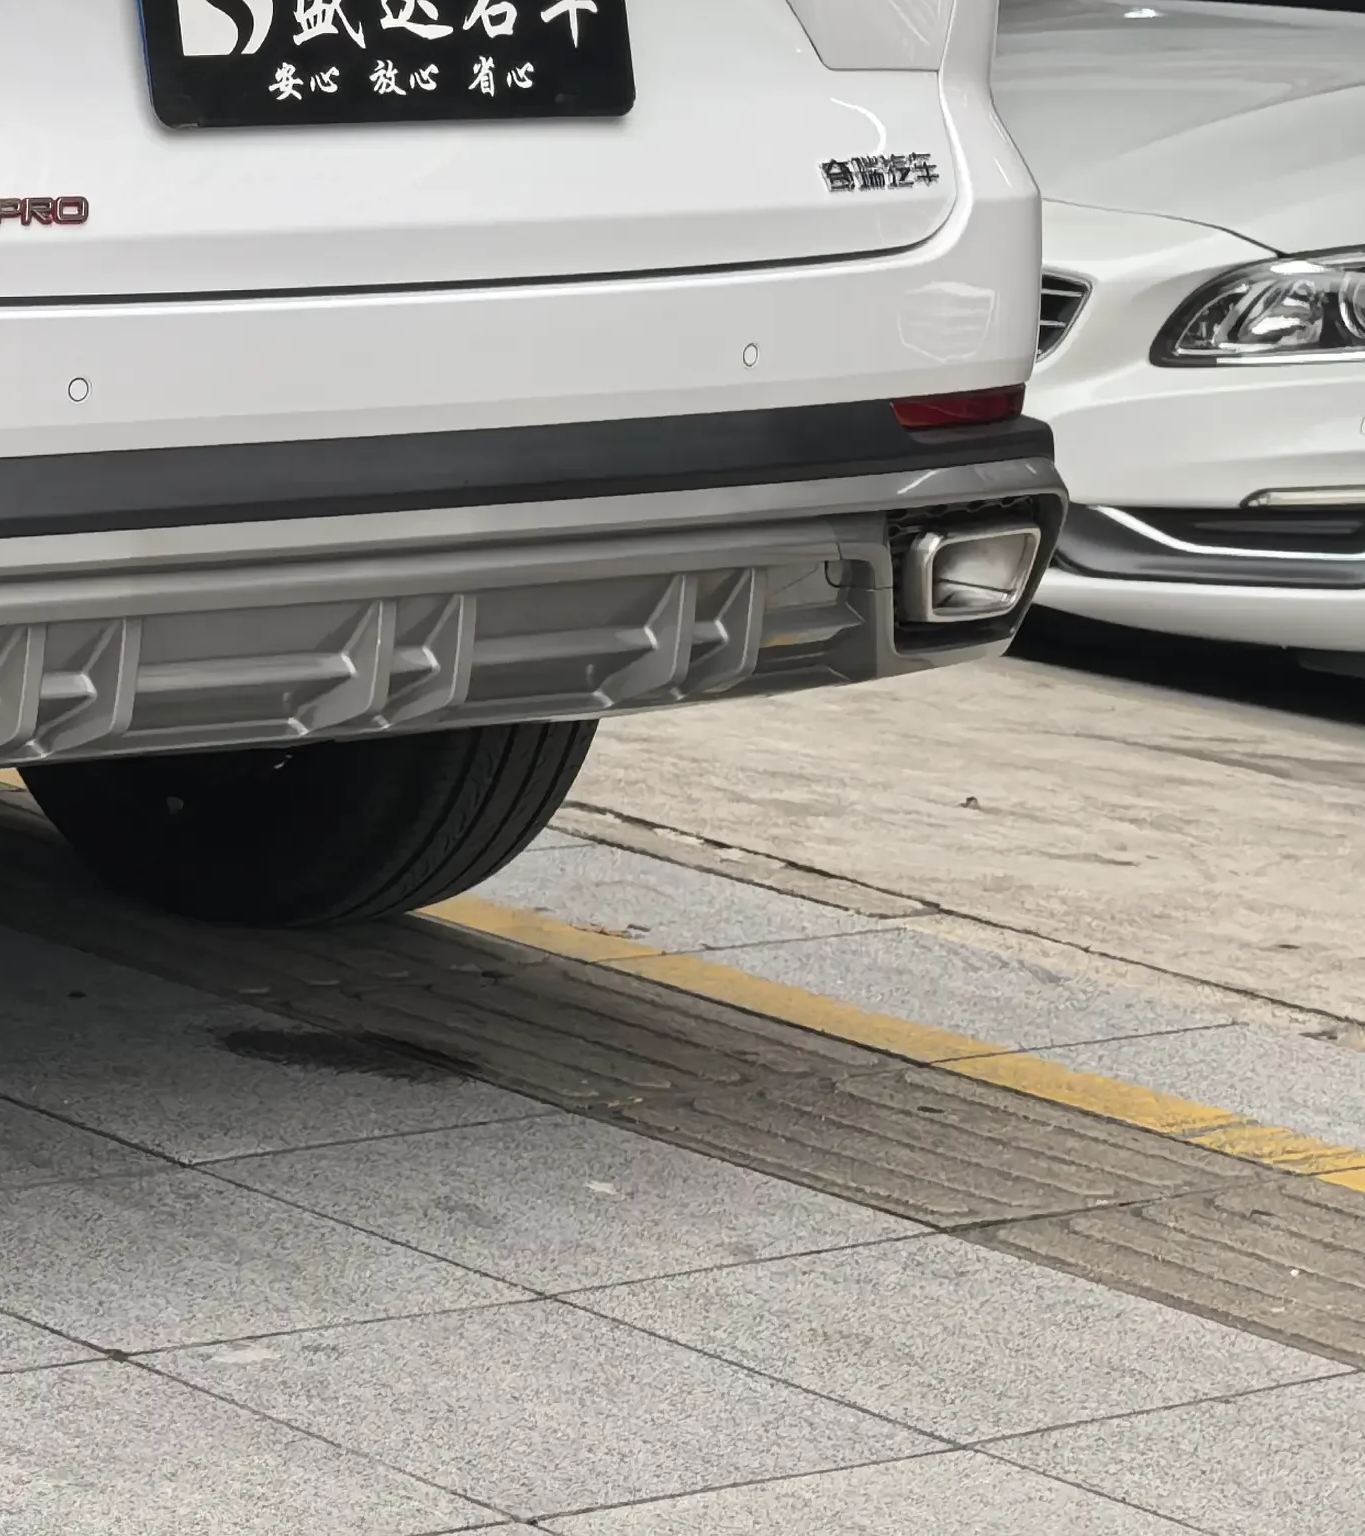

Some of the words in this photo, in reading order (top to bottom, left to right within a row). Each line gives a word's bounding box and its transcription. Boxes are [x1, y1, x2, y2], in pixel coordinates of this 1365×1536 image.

[268, 62, 341, 100] 安心
[369, 59, 439, 97] 放心
[469, 57, 535, 97] 省心
